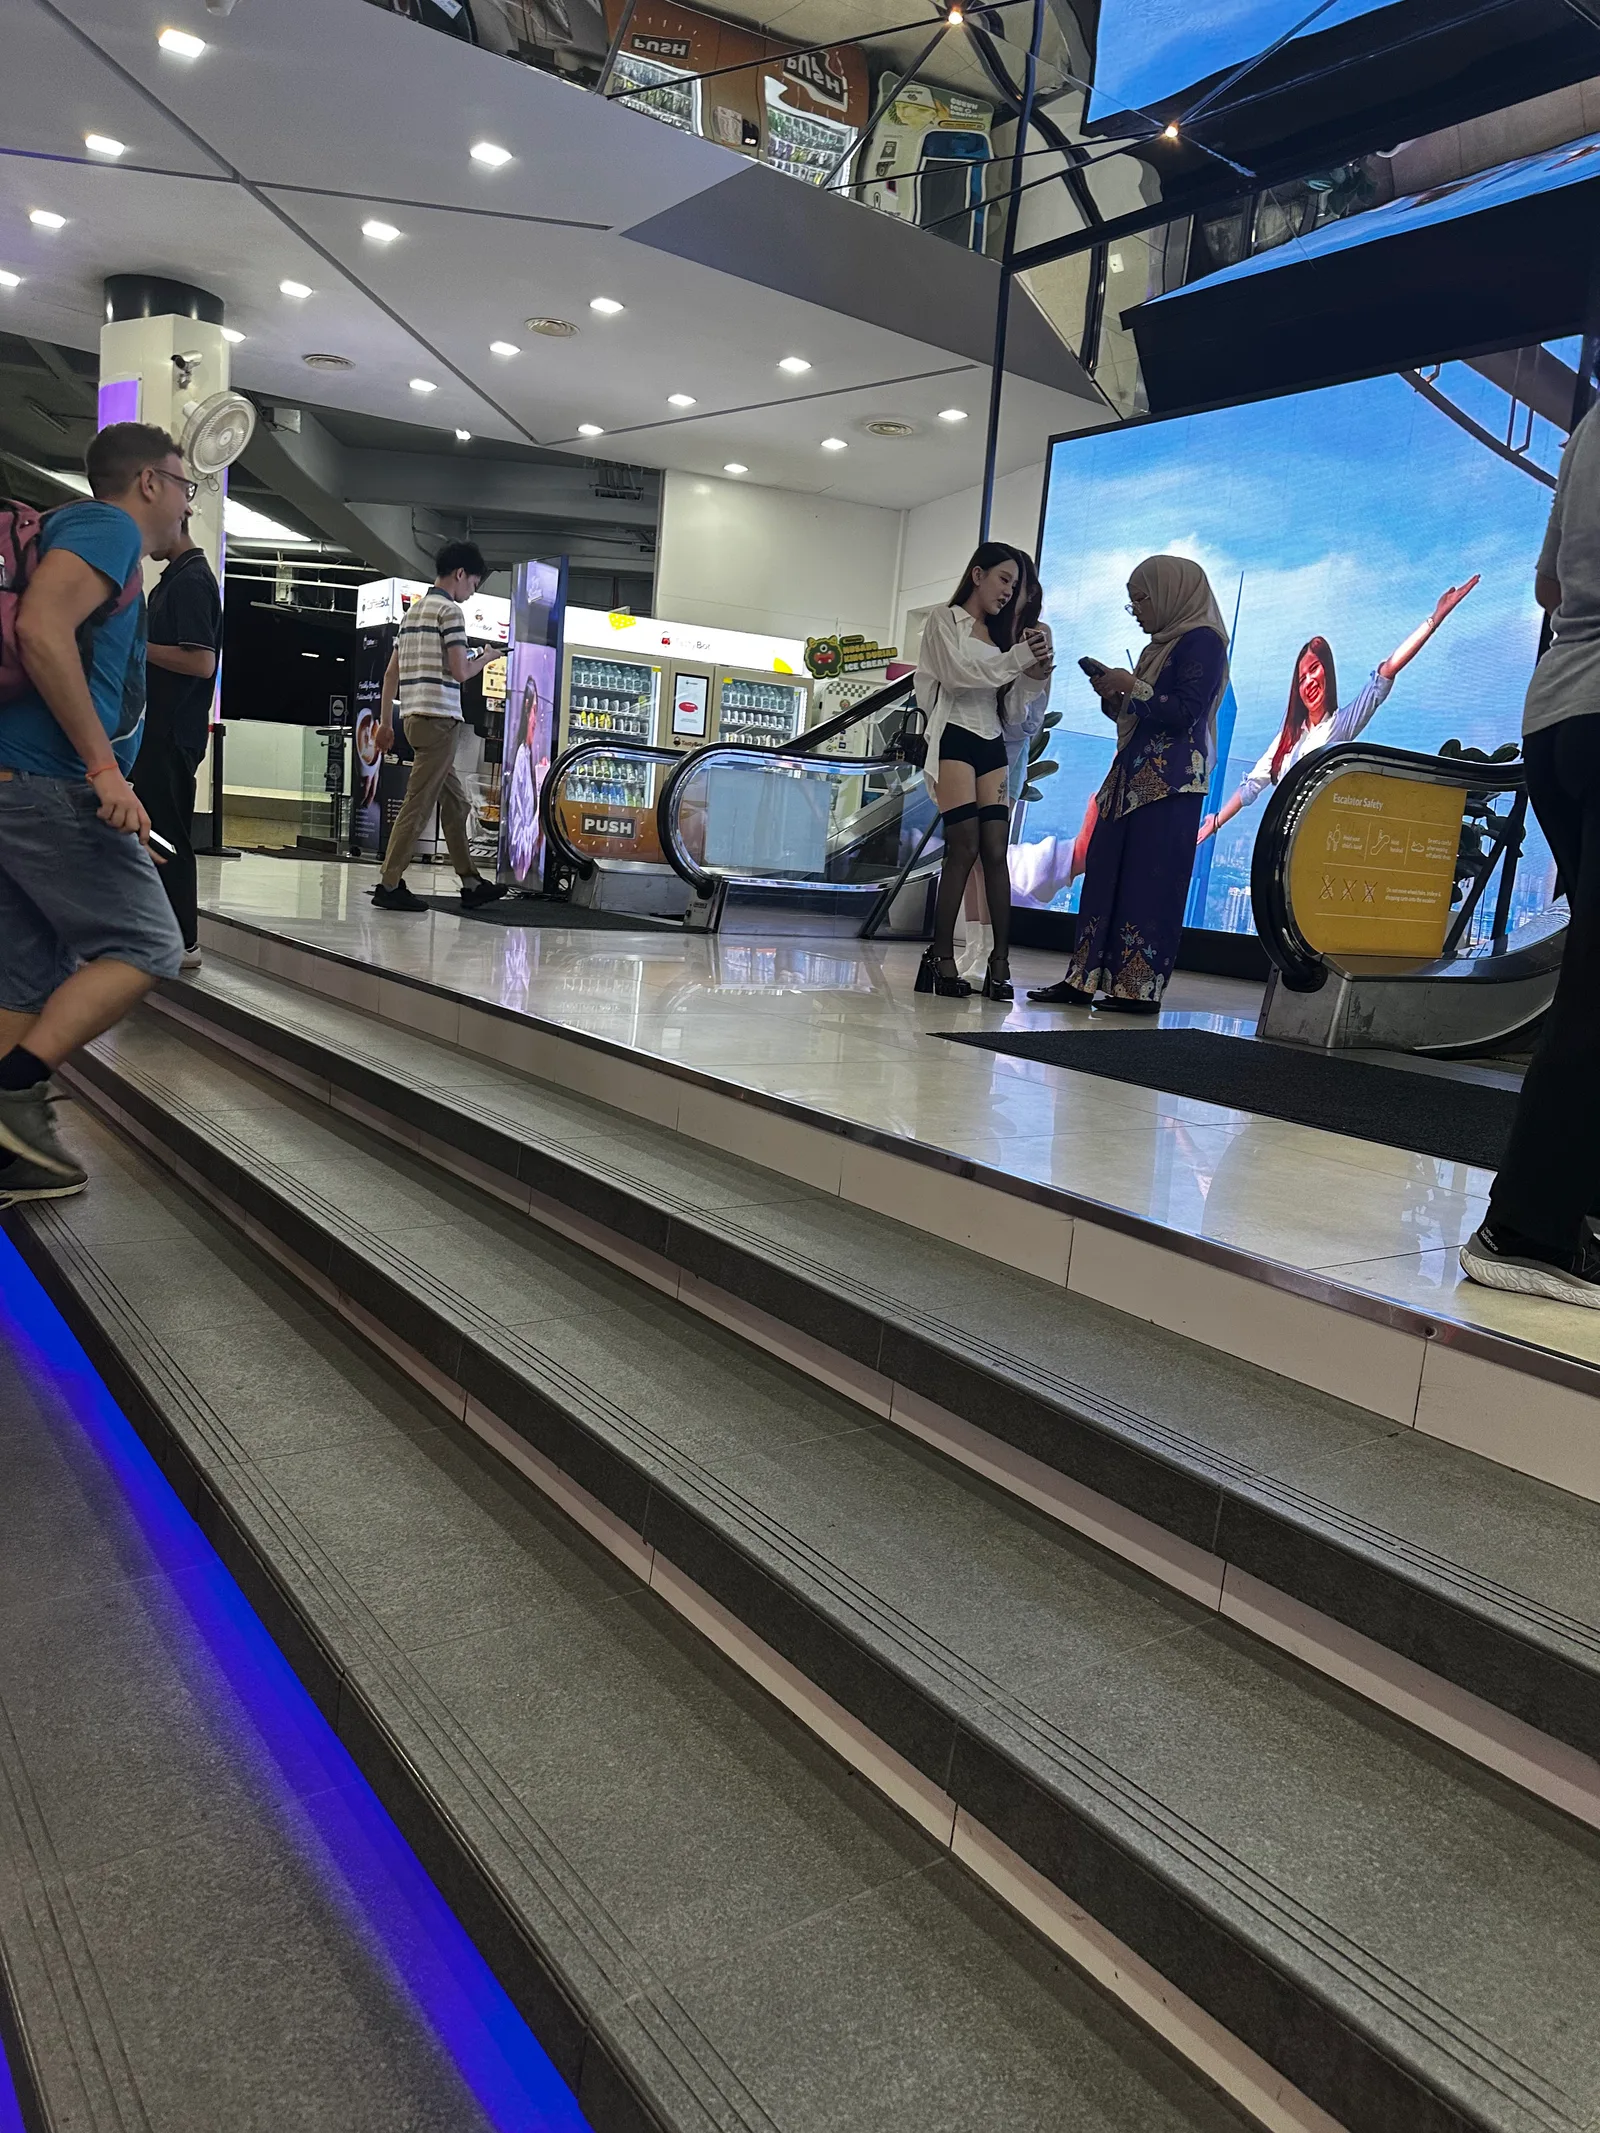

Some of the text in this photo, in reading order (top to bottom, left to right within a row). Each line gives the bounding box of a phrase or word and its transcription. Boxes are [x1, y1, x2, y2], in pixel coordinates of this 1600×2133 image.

[844, 658, 890, 672] ICE CREAM
[1333, 793, 1384, 811] Escalator Safety
[584, 818, 632, 834] PUSH
[1480, 1229, 1499, 1252] balance
